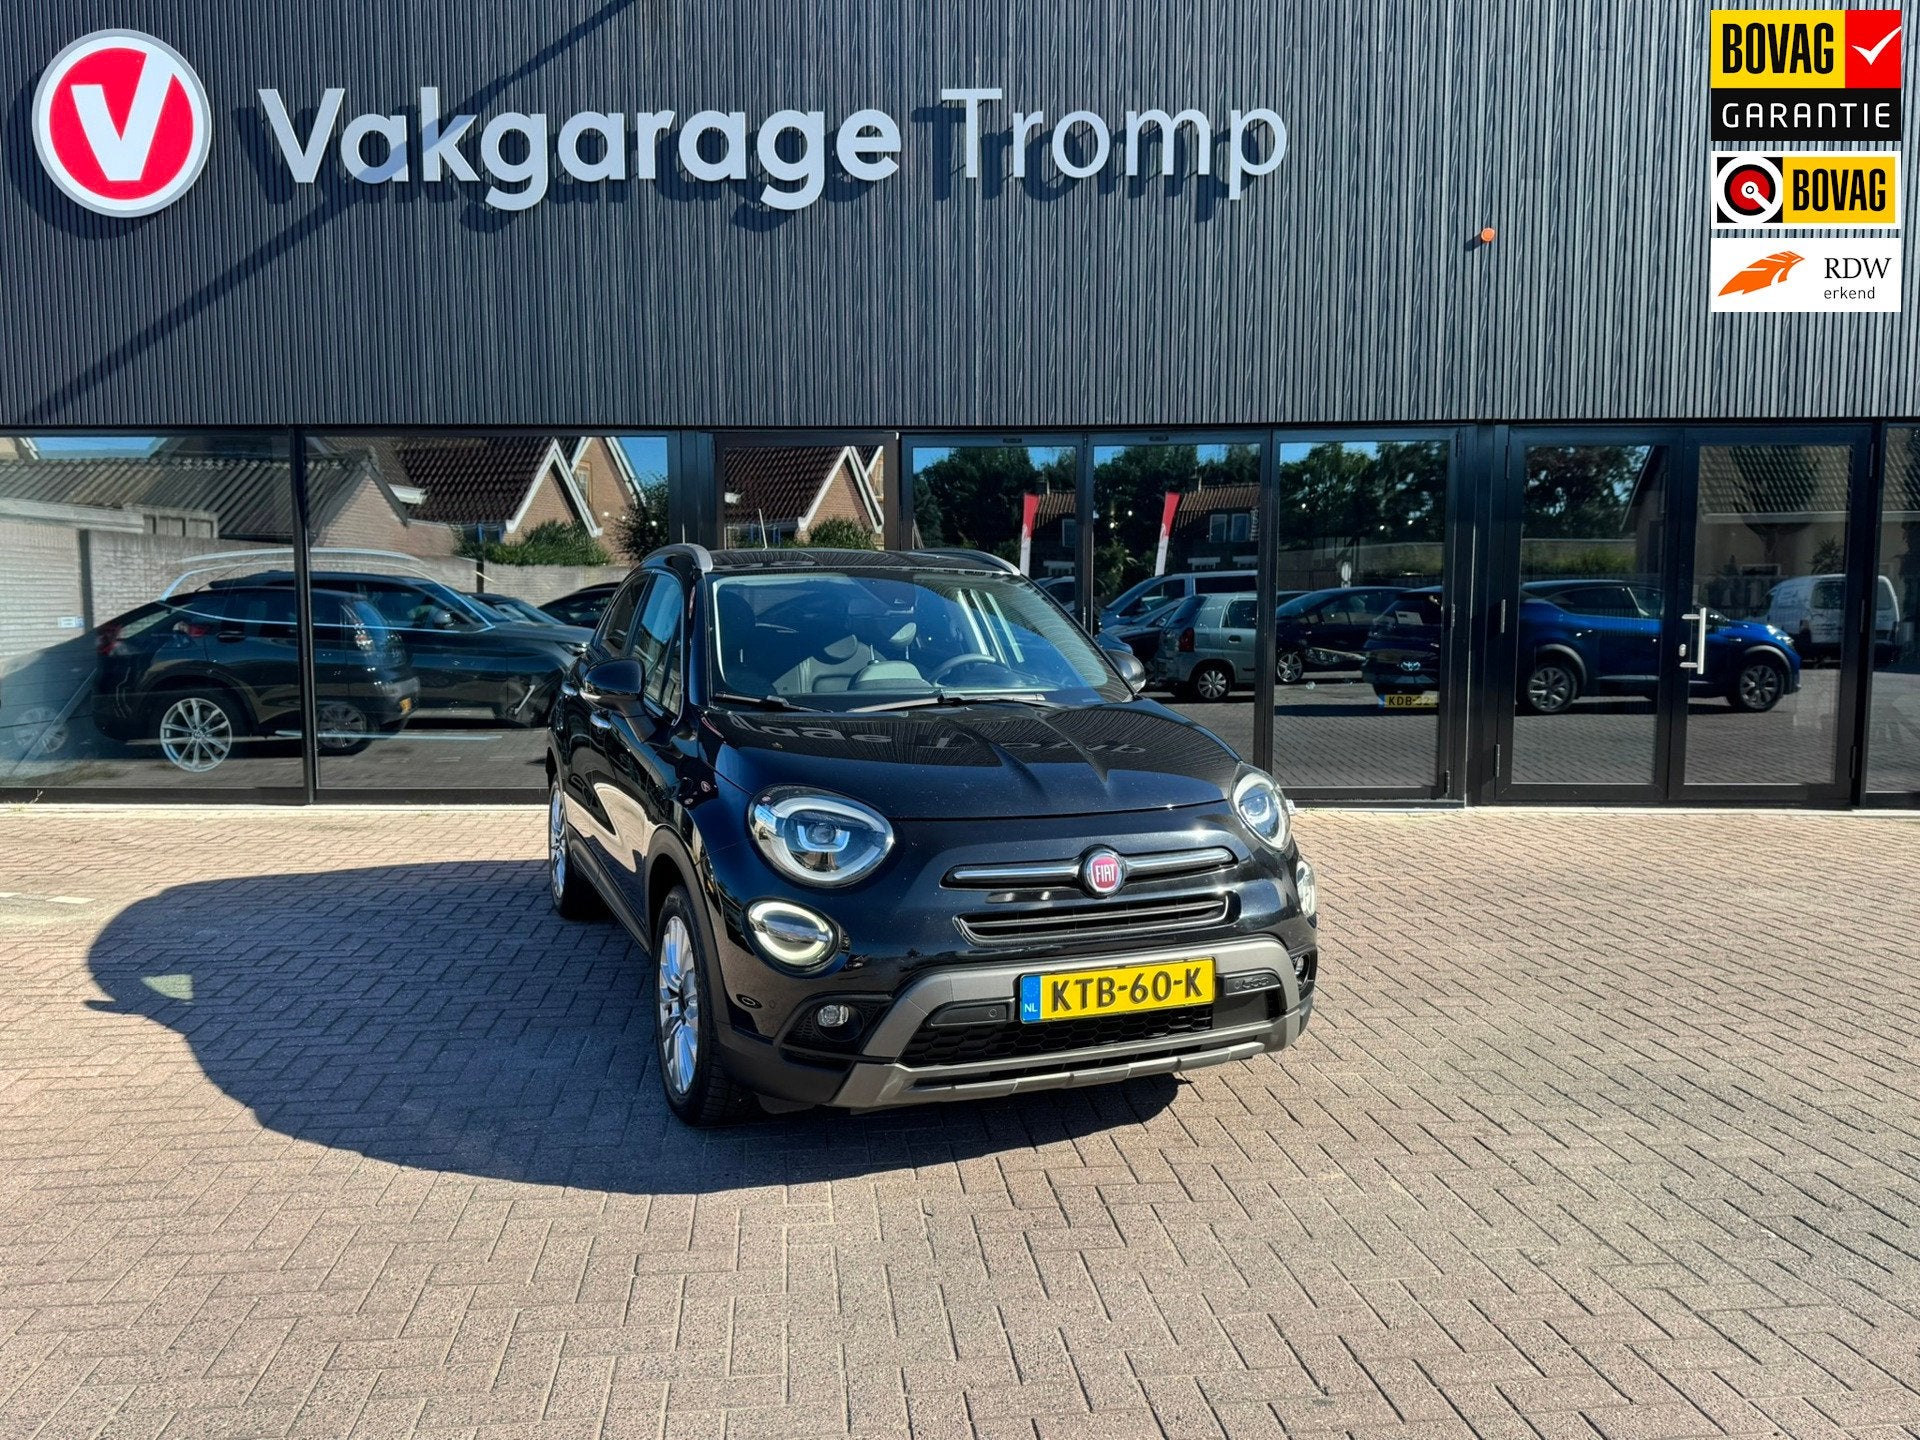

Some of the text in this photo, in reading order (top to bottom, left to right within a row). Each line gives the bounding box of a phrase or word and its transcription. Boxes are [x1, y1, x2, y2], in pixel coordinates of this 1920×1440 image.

[258, 86, 1287, 211] Vakgarage Tromp
[1095, 863, 1115, 883] FIAT
[1051, 966, 1203, 1013] KTB-60-K
[1024, 1004, 1039, 1013] NL
